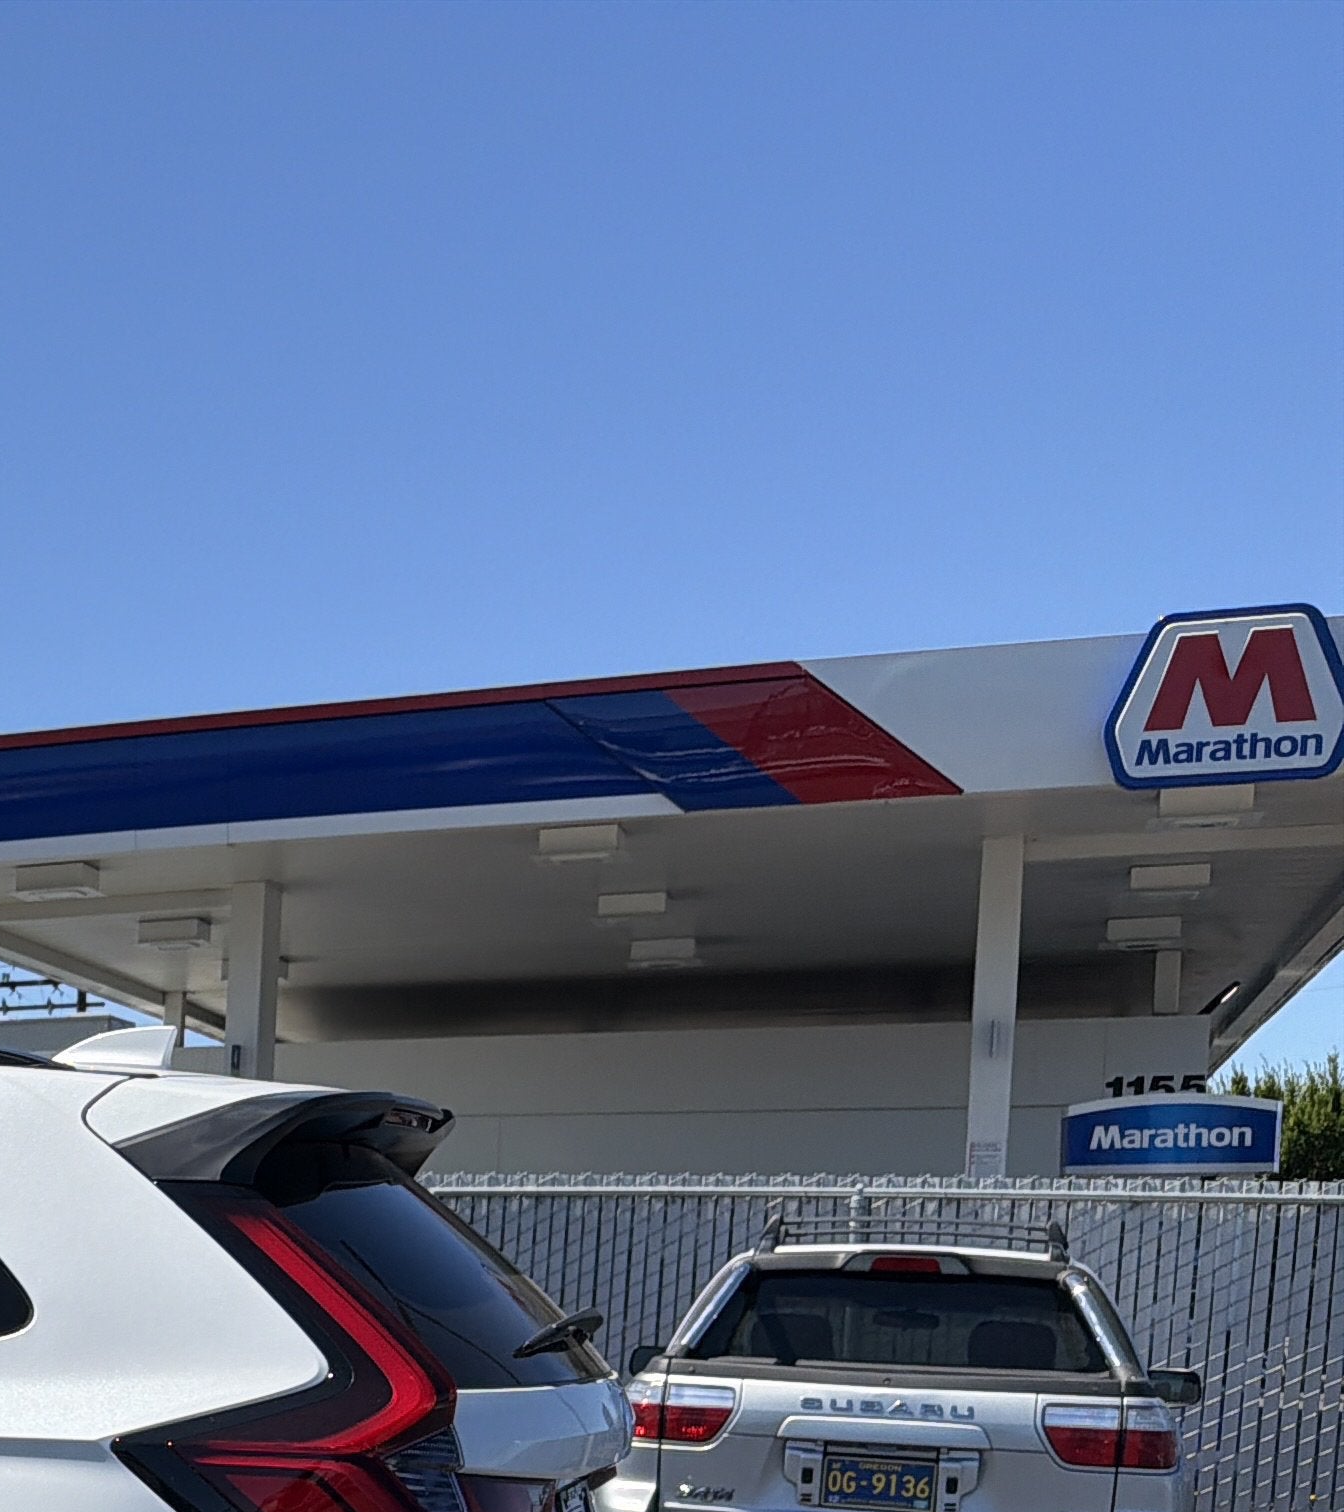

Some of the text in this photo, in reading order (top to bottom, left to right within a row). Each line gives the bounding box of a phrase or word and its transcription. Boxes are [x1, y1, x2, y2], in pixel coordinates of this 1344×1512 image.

[1134, 732, 1324, 767] Marathon
[1105, 1074, 1207, 1098] 1155
[1089, 1122, 1253, 1151] Marathon
[800, 1397, 975, 1420] SUBARU
